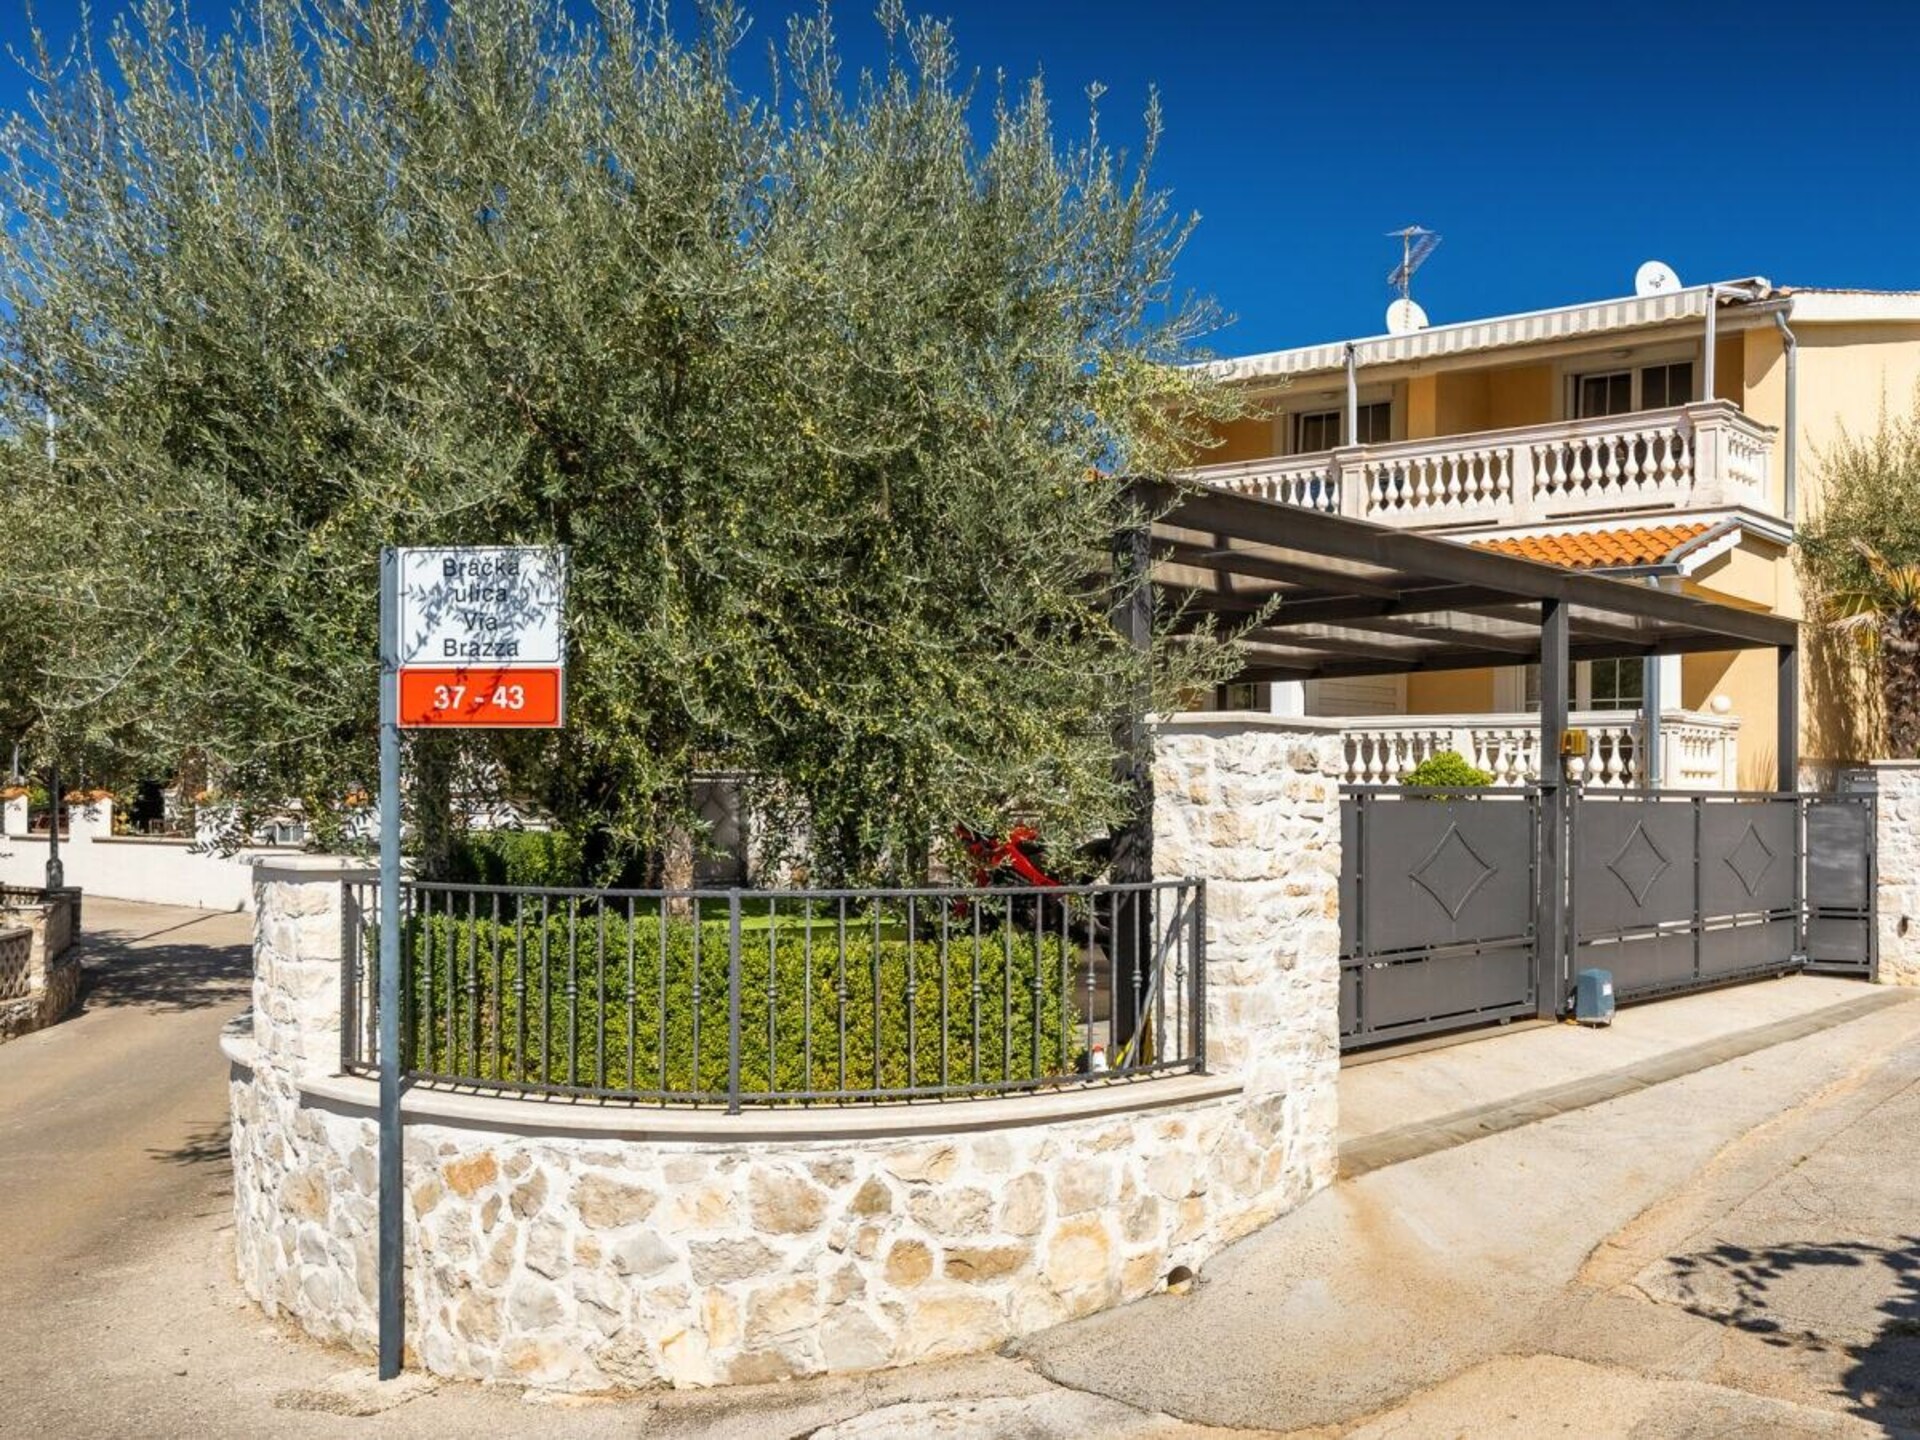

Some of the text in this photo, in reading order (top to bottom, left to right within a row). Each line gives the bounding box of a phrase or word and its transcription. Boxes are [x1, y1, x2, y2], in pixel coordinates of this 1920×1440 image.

[455, 585, 507, 602] ulica
[464, 612, 498, 631] Via
[444, 638, 519, 657] Brazza
[434, 686, 465, 710] 37
[492, 686, 525, 710] 43
